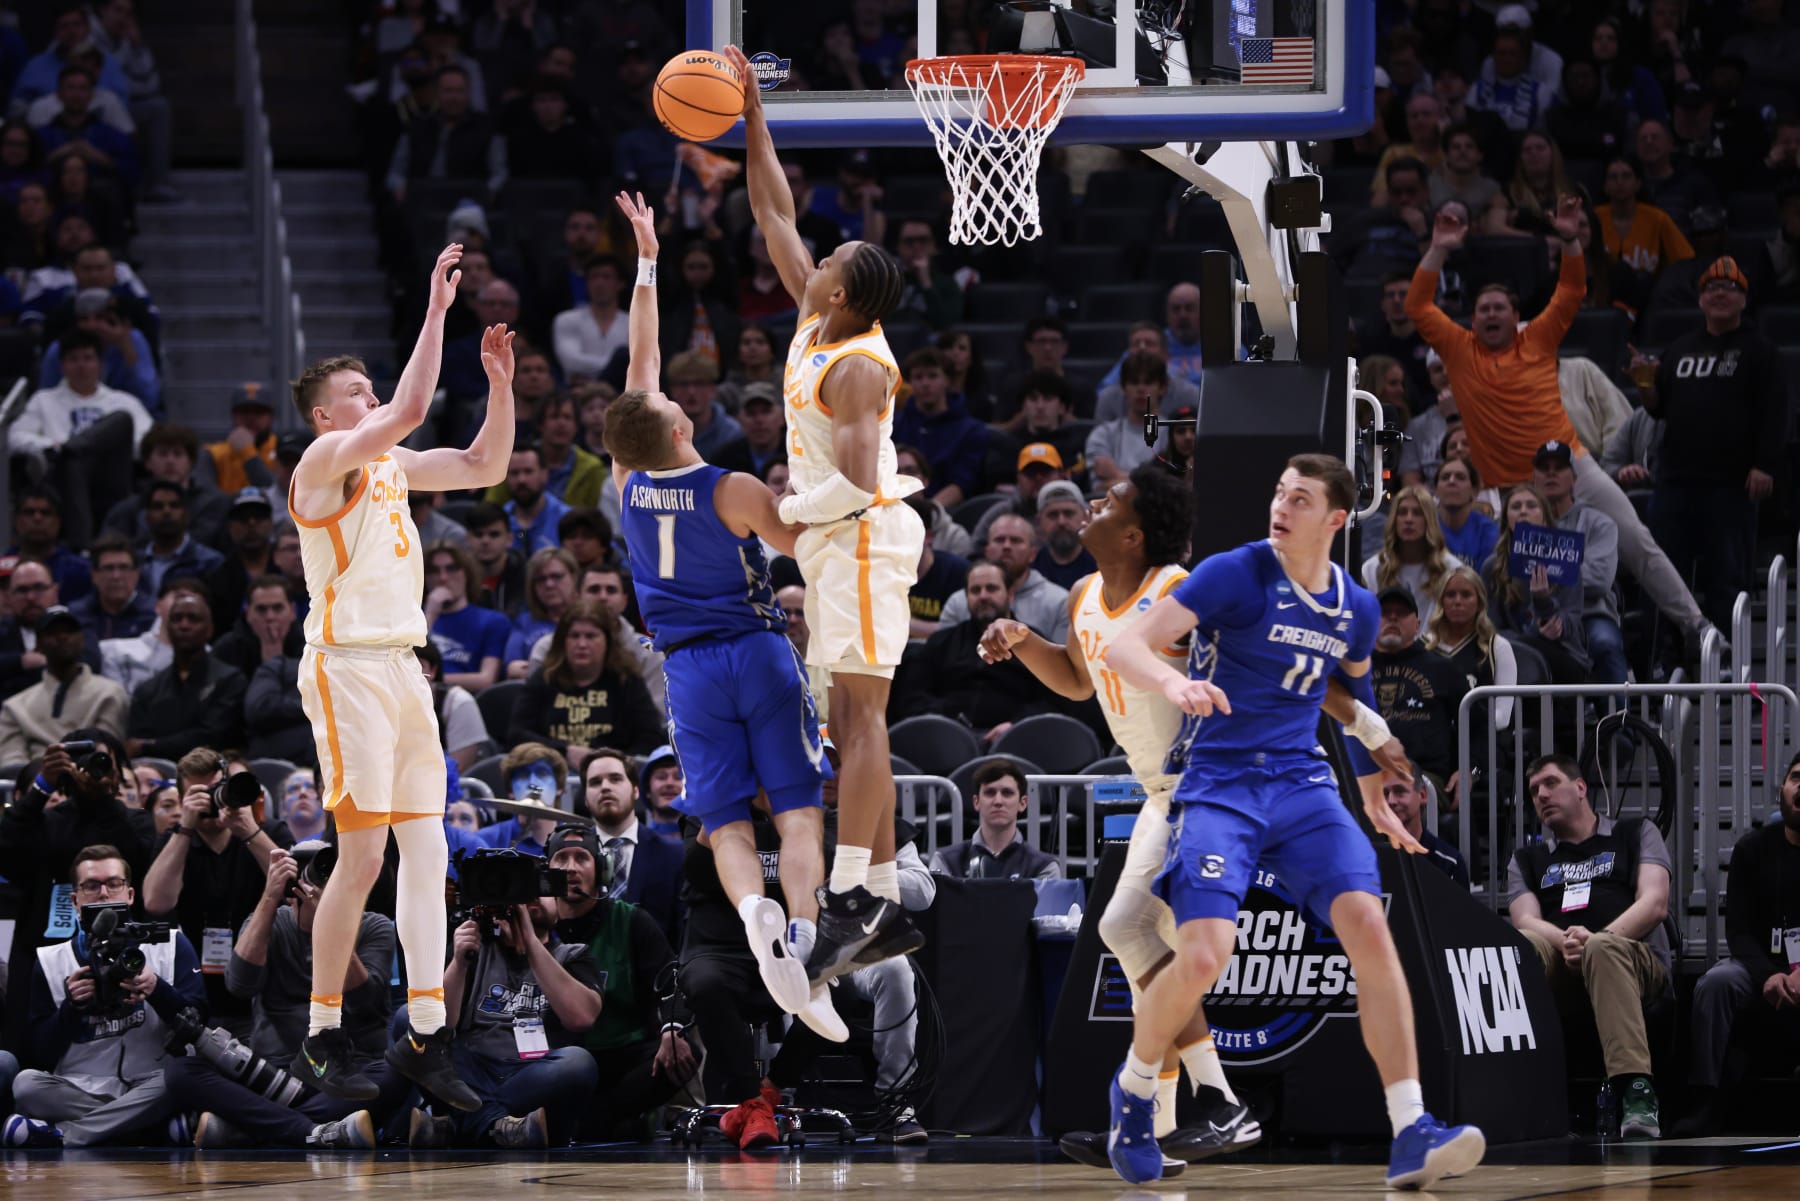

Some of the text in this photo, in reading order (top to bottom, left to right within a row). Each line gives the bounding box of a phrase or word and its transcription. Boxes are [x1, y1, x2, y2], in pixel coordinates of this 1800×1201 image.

[751, 62, 777, 71] MARCH
[629, 484, 695, 511] ASHWORTH
[389, 511, 411, 558] 3
[653, 512, 677, 580] 1
[1513, 540, 1580, 564] BLUEJAYS!
[1099, 668, 1127, 716] 11
[1281, 652, 1325, 696] 11
[568, 706, 591, 724] UP
[1255, 869, 1276, 888] 16
[1235, 910, 1306, 951] RCH
[1207, 954, 1359, 995] ADNES
[1444, 945, 1537, 1055] NCAA
[1210, 1028, 1269, 1048] ELITE 8
